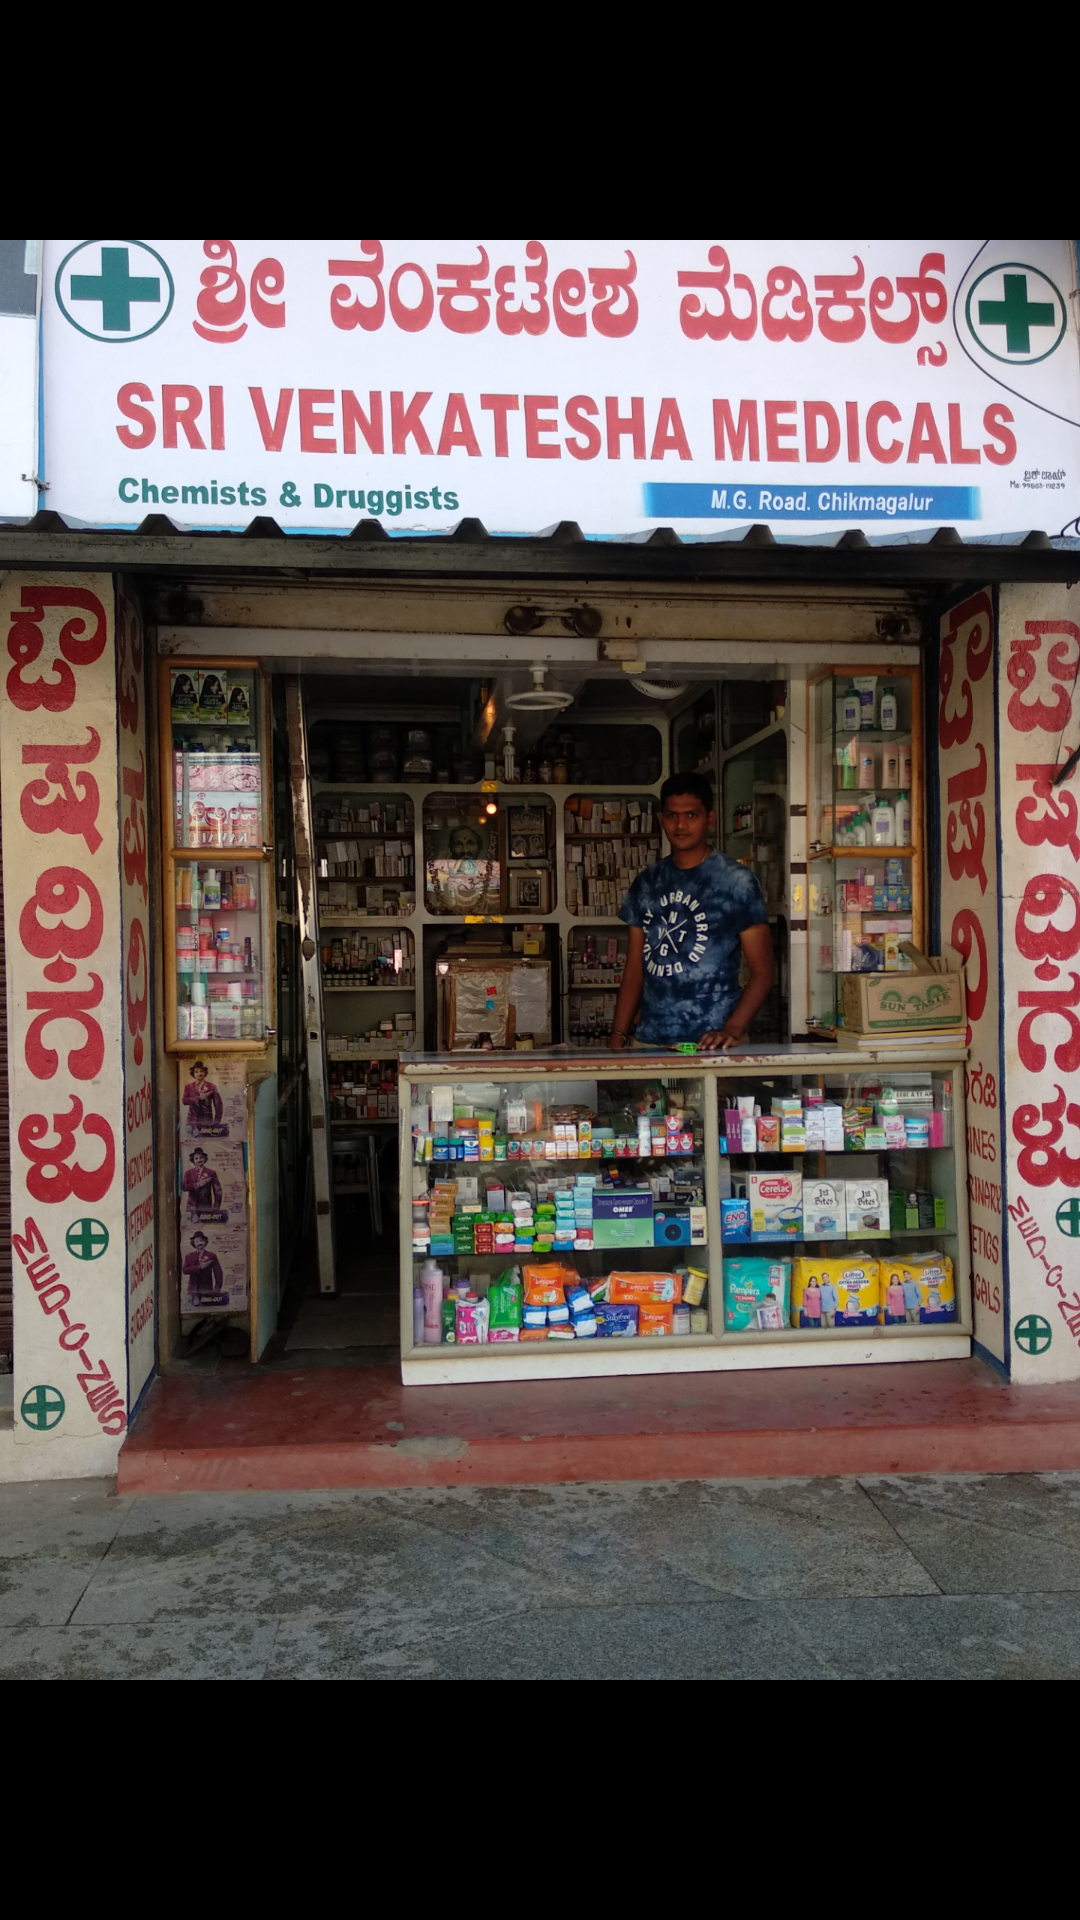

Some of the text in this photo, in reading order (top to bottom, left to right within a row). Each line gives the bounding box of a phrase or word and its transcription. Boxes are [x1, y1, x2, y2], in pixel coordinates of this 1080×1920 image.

[193, 240, 949, 366] ಶ್ರೀ ವೆಂಕಟೇಶ ಮೆಡಿಕಲ್ಸ್
[115, 382, 1018, 466] SRI VENKATESHA MEDICALS
[118, 477, 460, 516] Chemists & Druggists
[711, 489, 752, 510] M.G.
[817, 491, 934, 516] Chikmagalur
[660, 890, 700, 912] URBAN
[687, 912, 708, 963] BRAND
[647, 961, 683, 977] DENIM
[880, 1001, 906, 1011] SUN
[913, 991, 951, 1012] TASTE
[760, 1185, 790, 1194] Cerelac
[819, 1188, 830, 1196] 1st
[862, 1190, 872, 1198] 1st
[968, 1173, 1002, 1214] RINARY
[814, 1196, 834, 1206] Bites
[857, 1198, 876, 1206] Bites
[612, 1206, 634, 1214] OMEE
[725, 1213, 747, 1223] ENO
[971, 1223, 999, 1265] ETICS
[844, 1271, 862, 1279] Lifree
[923, 1269, 941, 1277] Lifree
[730, 1283, 760, 1296] Pampers
[605, 1313, 631, 1323] Stayfree
